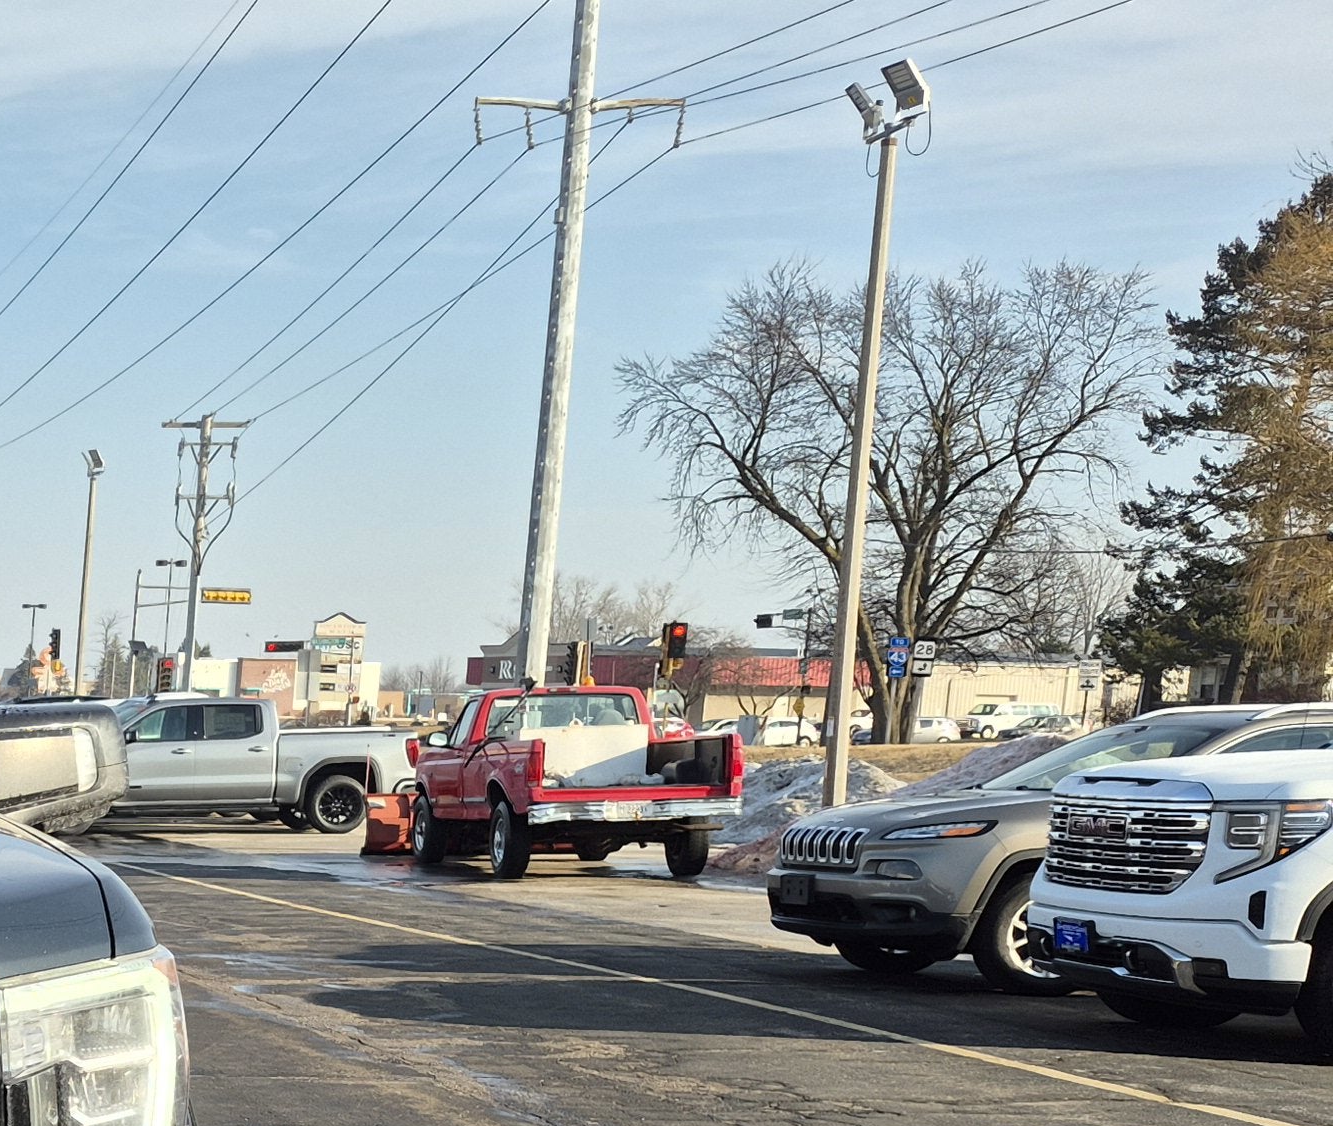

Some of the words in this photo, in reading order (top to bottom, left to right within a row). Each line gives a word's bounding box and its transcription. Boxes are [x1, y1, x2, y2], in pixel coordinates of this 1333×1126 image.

[916, 644, 934, 655] 28
[890, 651, 907, 663] 43
[1069, 815, 1125, 837] GMC
